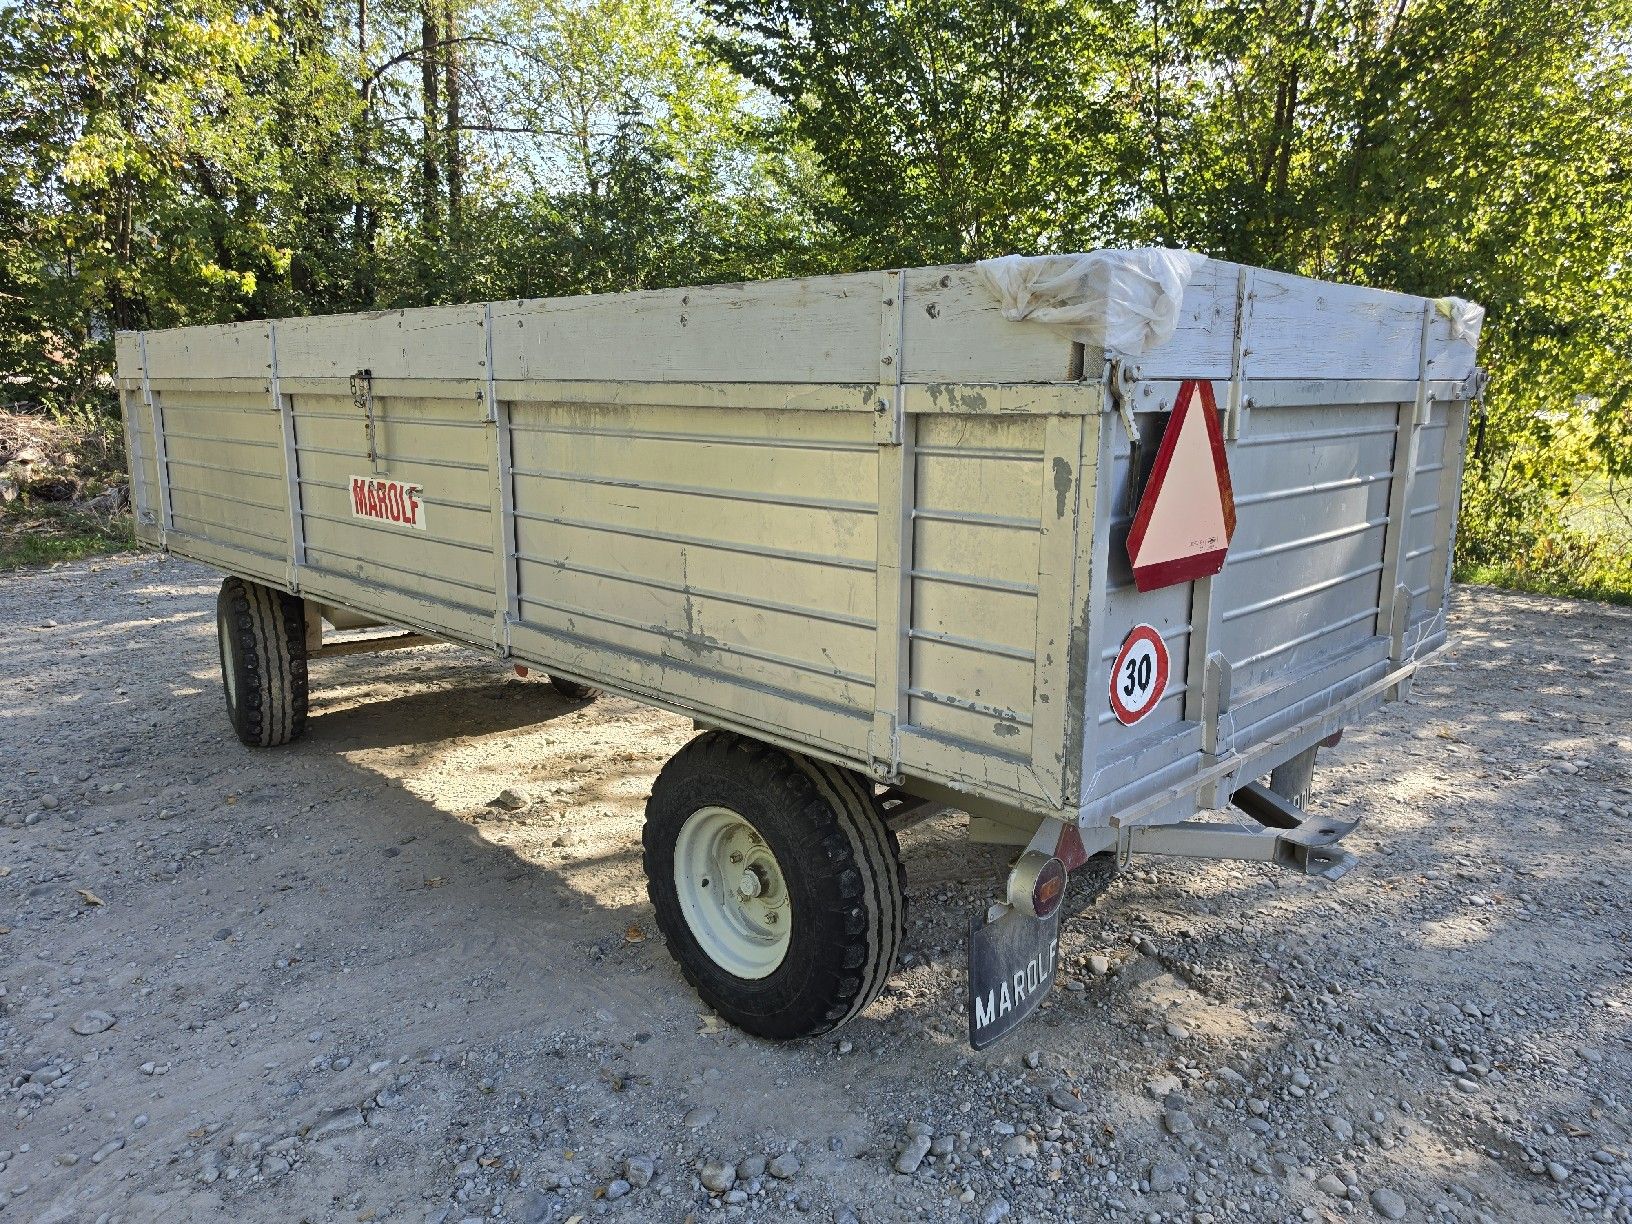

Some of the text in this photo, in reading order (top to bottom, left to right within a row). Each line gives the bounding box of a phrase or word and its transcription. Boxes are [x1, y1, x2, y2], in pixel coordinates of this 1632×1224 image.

[353, 478, 419, 525] MAROLF
[1123, 653, 1151, 697] 30
[975, 938, 1058, 1030] MAROLF
